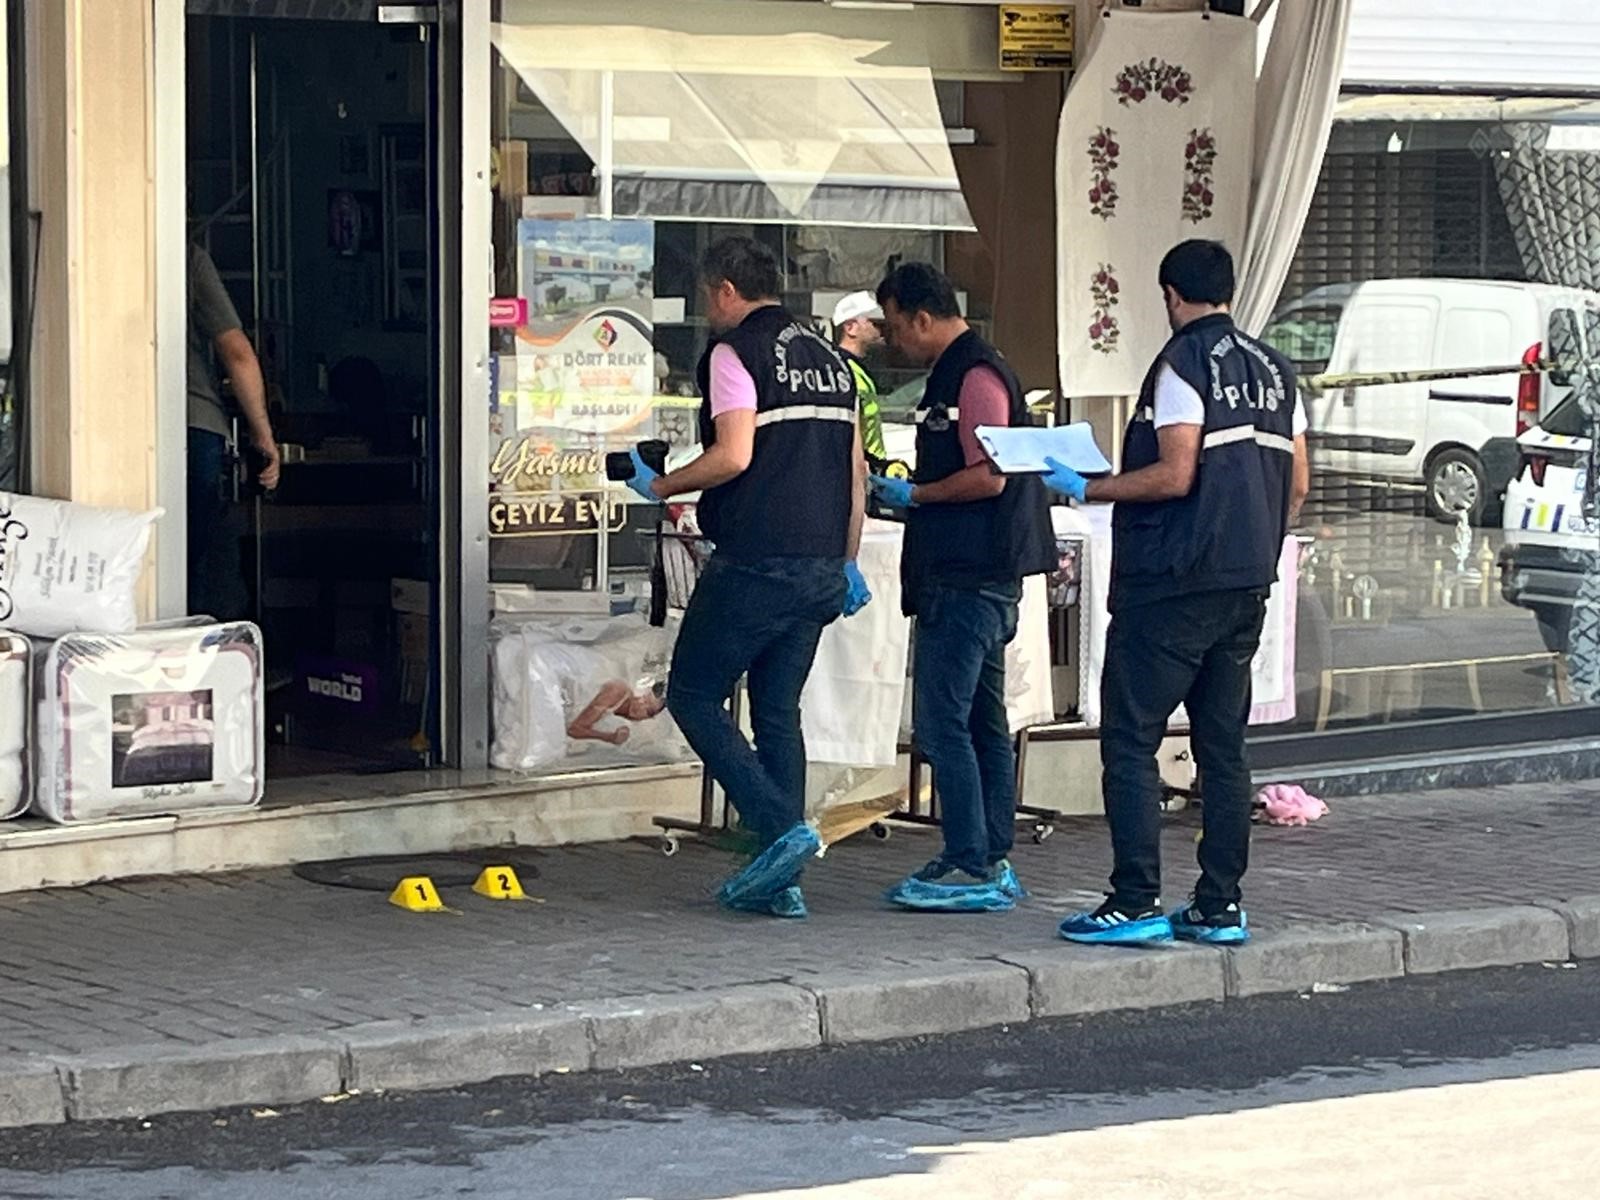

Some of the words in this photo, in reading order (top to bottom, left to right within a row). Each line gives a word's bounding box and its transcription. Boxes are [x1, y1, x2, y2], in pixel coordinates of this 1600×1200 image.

[608, 351, 647, 366] RENK
[789, 364, 850, 393] POLİS
[1223, 379, 1278, 411] PLİS
[307, 676, 363, 703] WORLD
[415, 884, 428, 901] 1
[497, 873, 511, 891] 2
